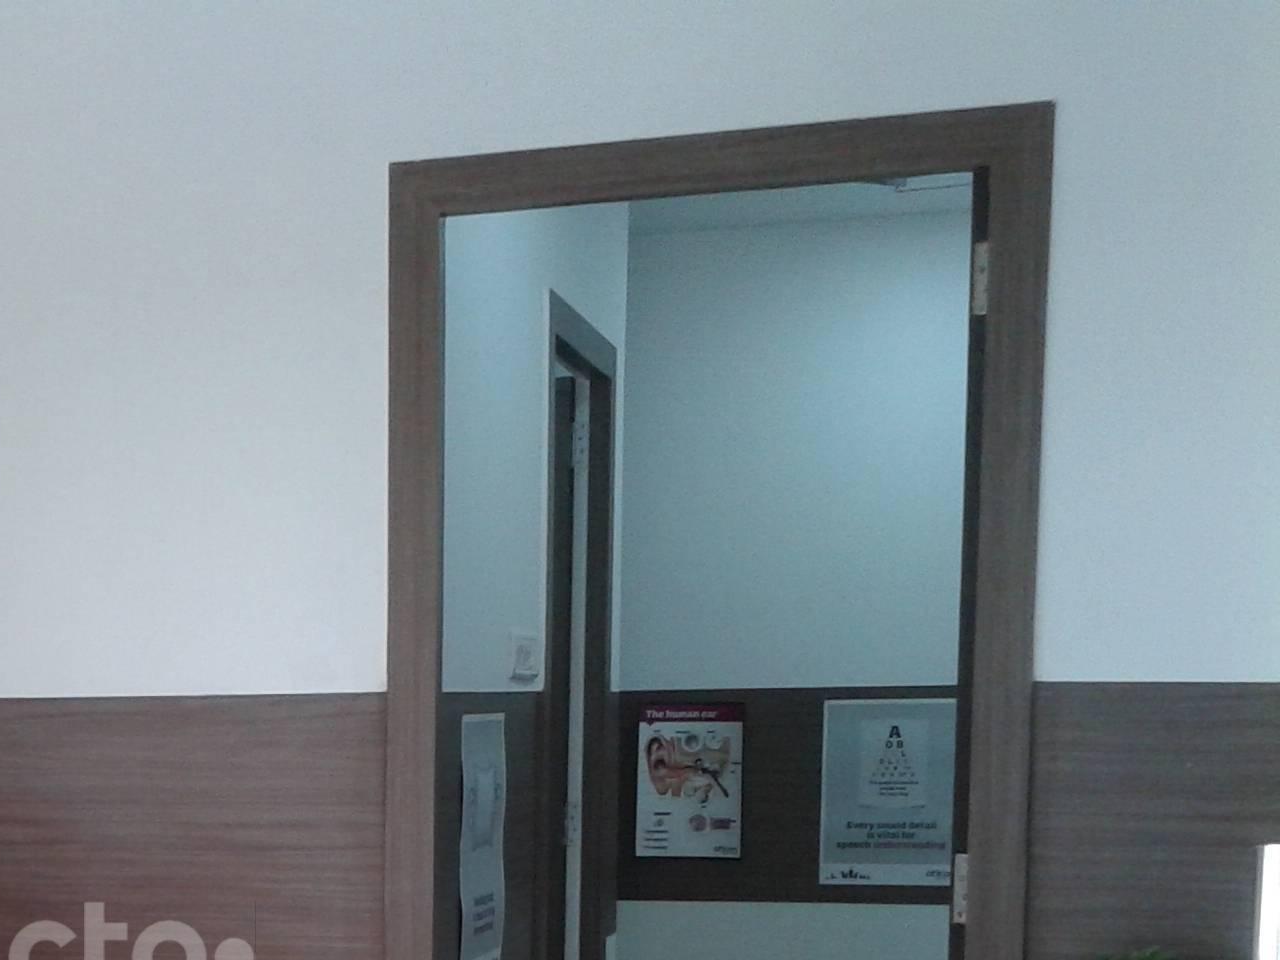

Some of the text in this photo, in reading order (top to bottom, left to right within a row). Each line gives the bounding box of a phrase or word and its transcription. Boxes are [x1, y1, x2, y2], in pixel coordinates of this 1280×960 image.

[646, 710, 664, 718] The
[665, 710, 699, 718] human
[889, 725, 901, 738] A
[846, 821, 873, 831] Every
